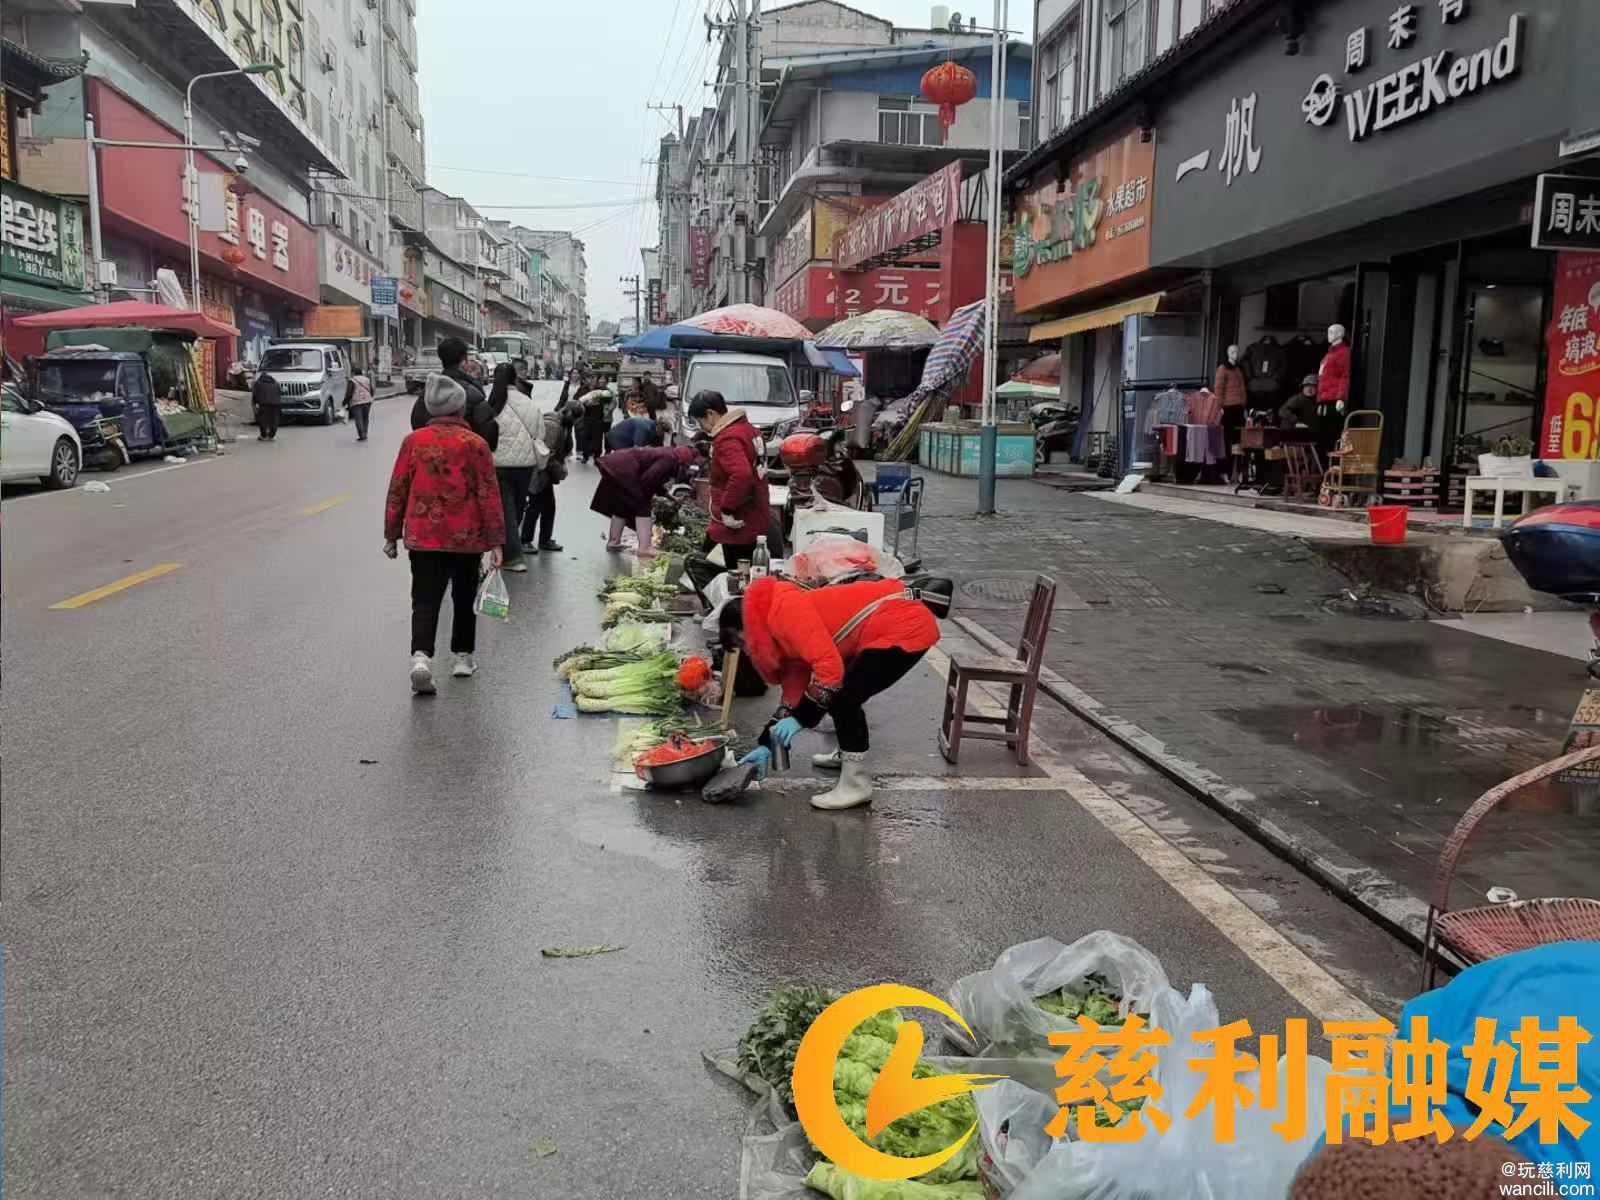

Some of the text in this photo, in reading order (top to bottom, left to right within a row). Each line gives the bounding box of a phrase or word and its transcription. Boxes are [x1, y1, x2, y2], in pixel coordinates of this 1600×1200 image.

[1343, 12, 1519, 142] WEEKend
[1175, 91, 1262, 187] 一帆
[1106, 175, 1148, 217] 水果超市
[1548, 192, 1600, 234] 周末
